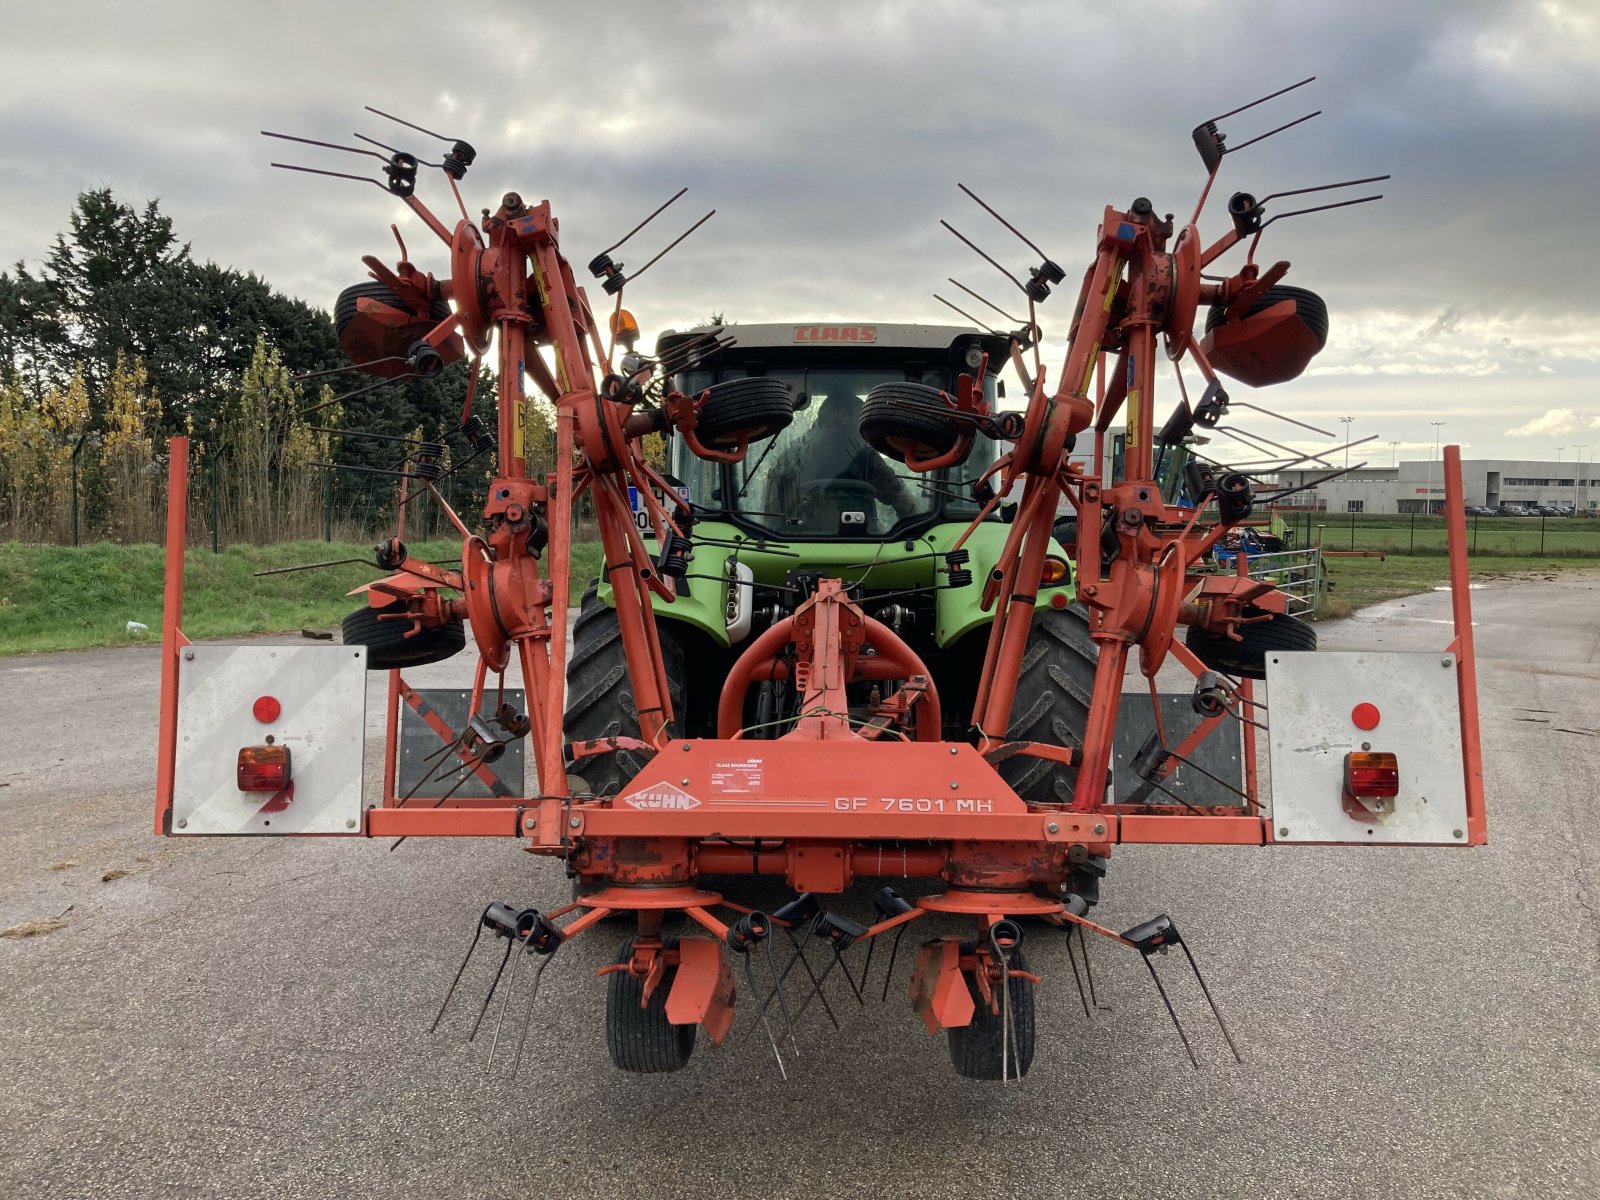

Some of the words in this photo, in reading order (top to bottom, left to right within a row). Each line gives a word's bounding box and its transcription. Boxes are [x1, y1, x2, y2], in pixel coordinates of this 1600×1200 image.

[795, 327, 876, 342] CLAAS
[634, 793, 690, 809] KUHN
[834, 797, 868, 811] GF
[881, 798, 945, 812] 7601
[956, 799, 993, 813] MH
